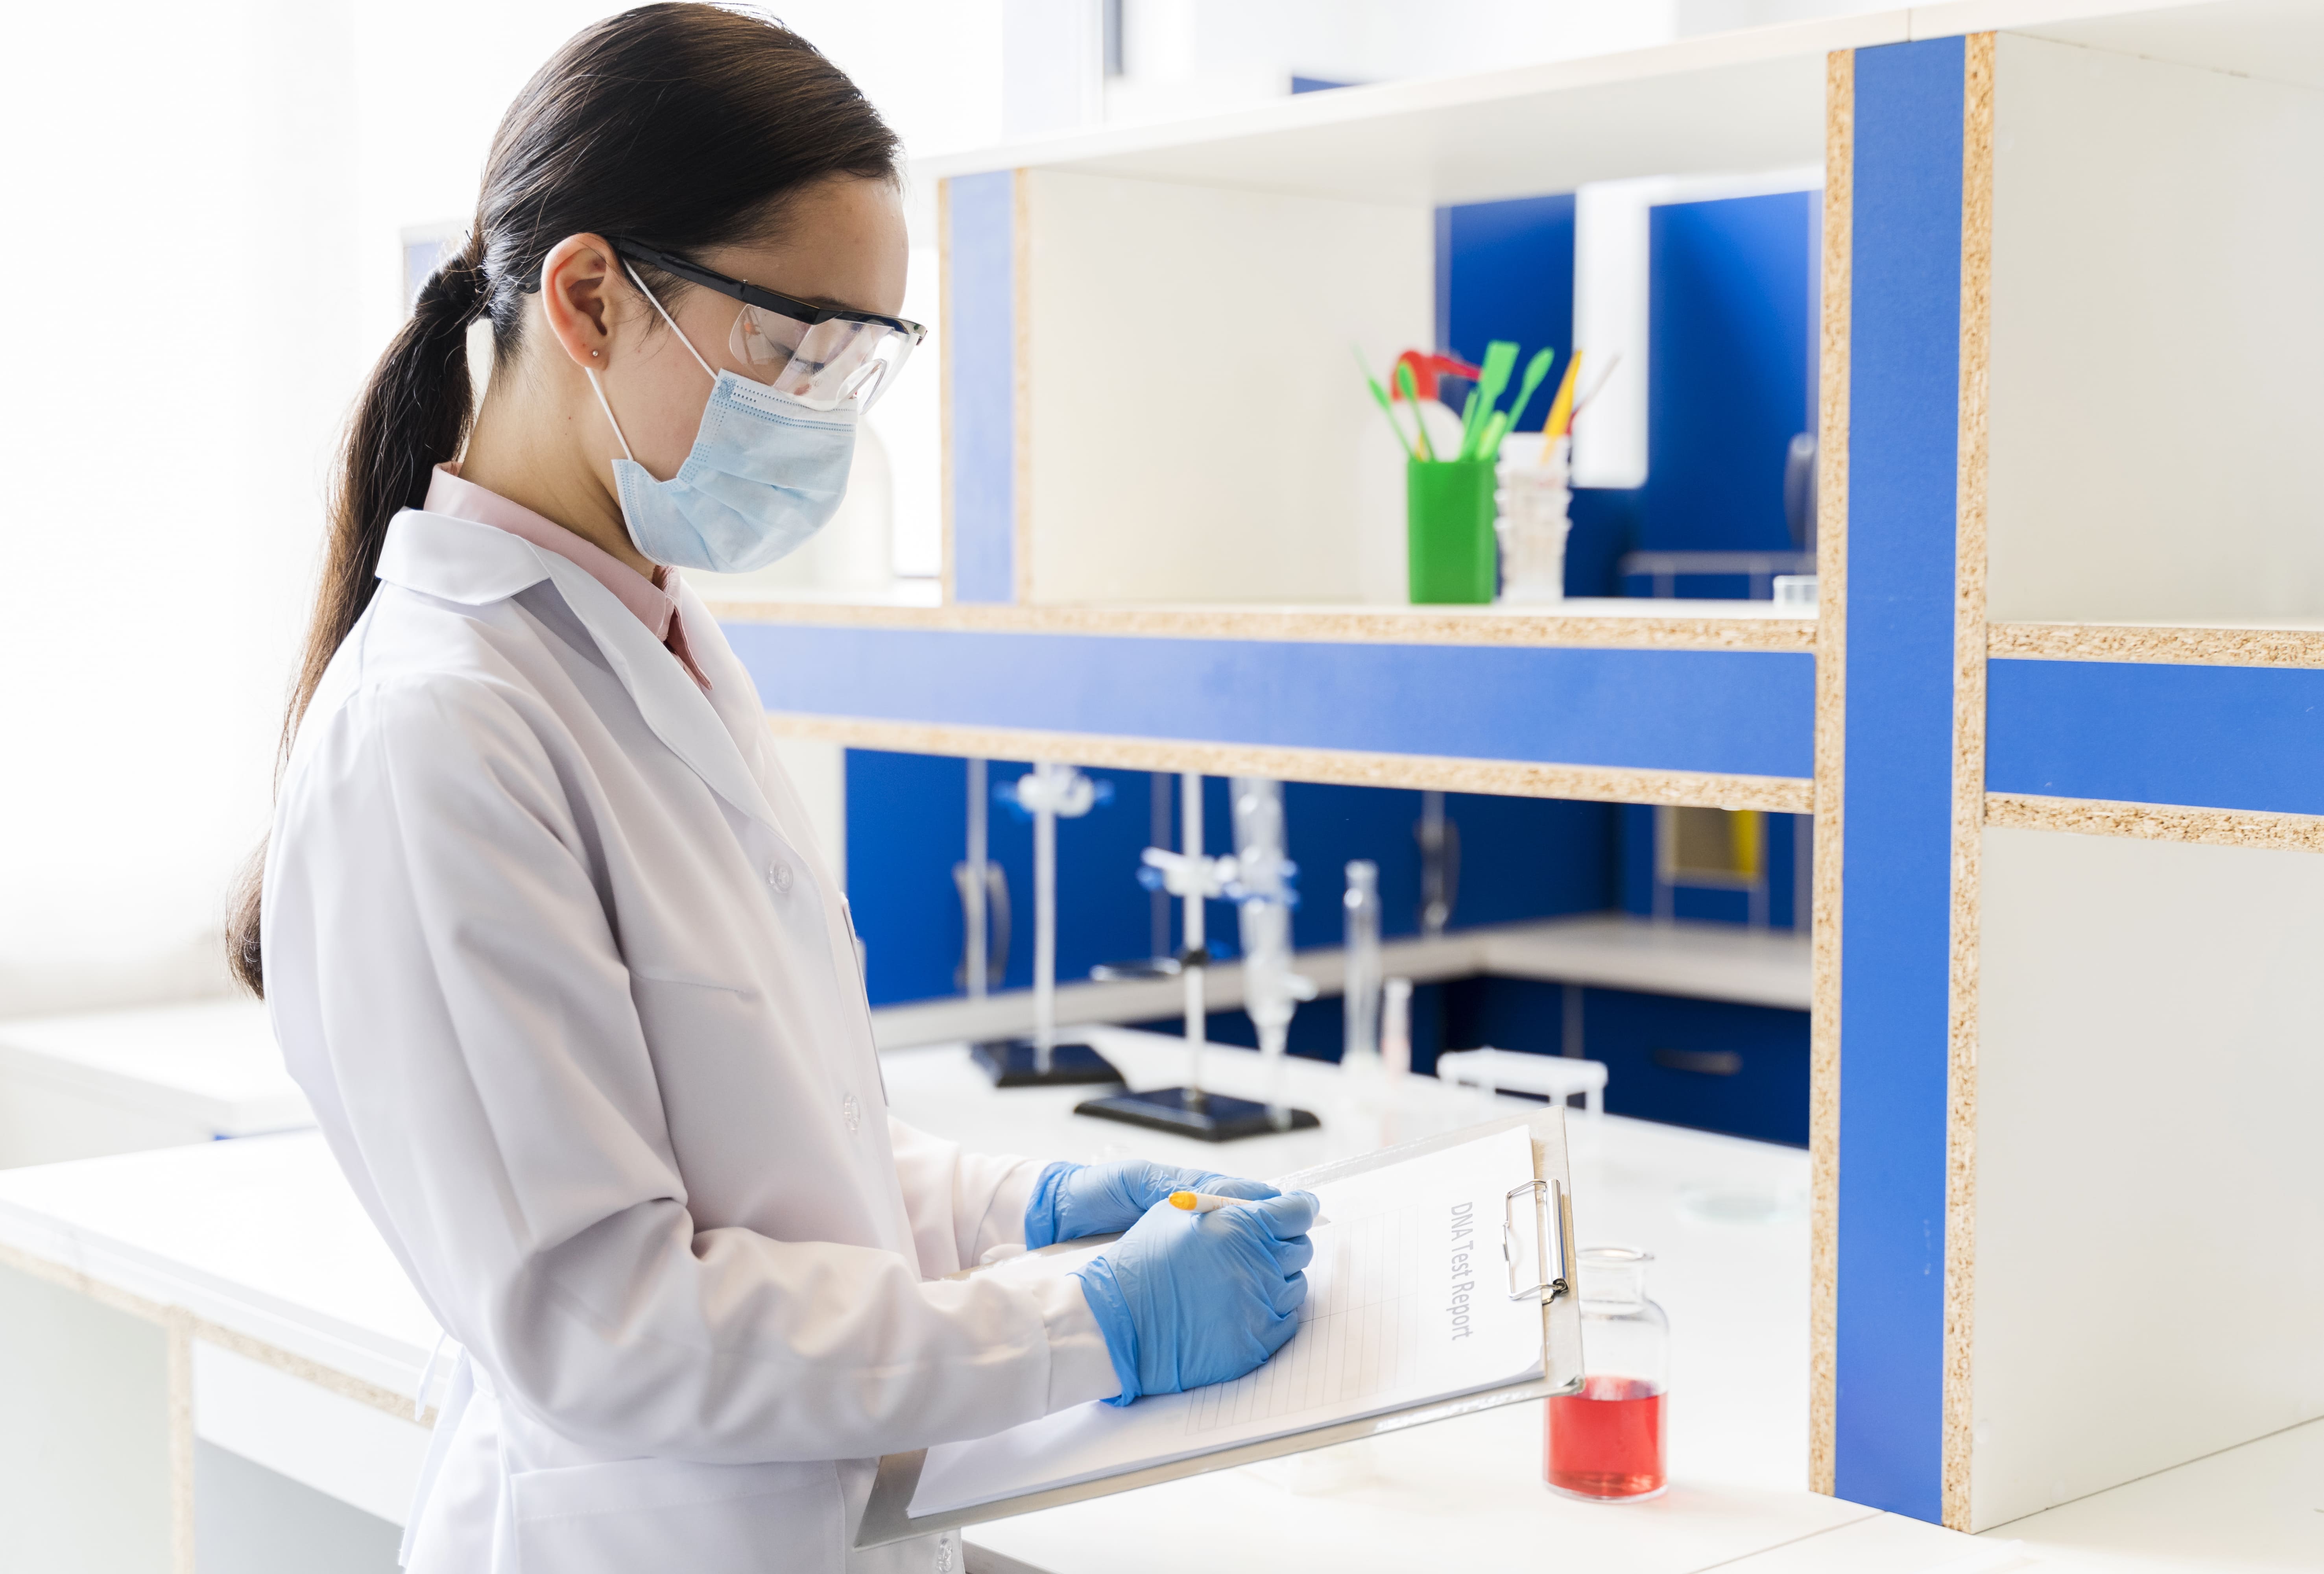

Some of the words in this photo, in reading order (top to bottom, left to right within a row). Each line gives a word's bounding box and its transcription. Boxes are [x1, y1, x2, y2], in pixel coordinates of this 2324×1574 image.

[1451, 1202, 1473, 1241] DNA
[1452, 1241, 1473, 1279] Test
[1446, 1281, 1475, 1340] Report
